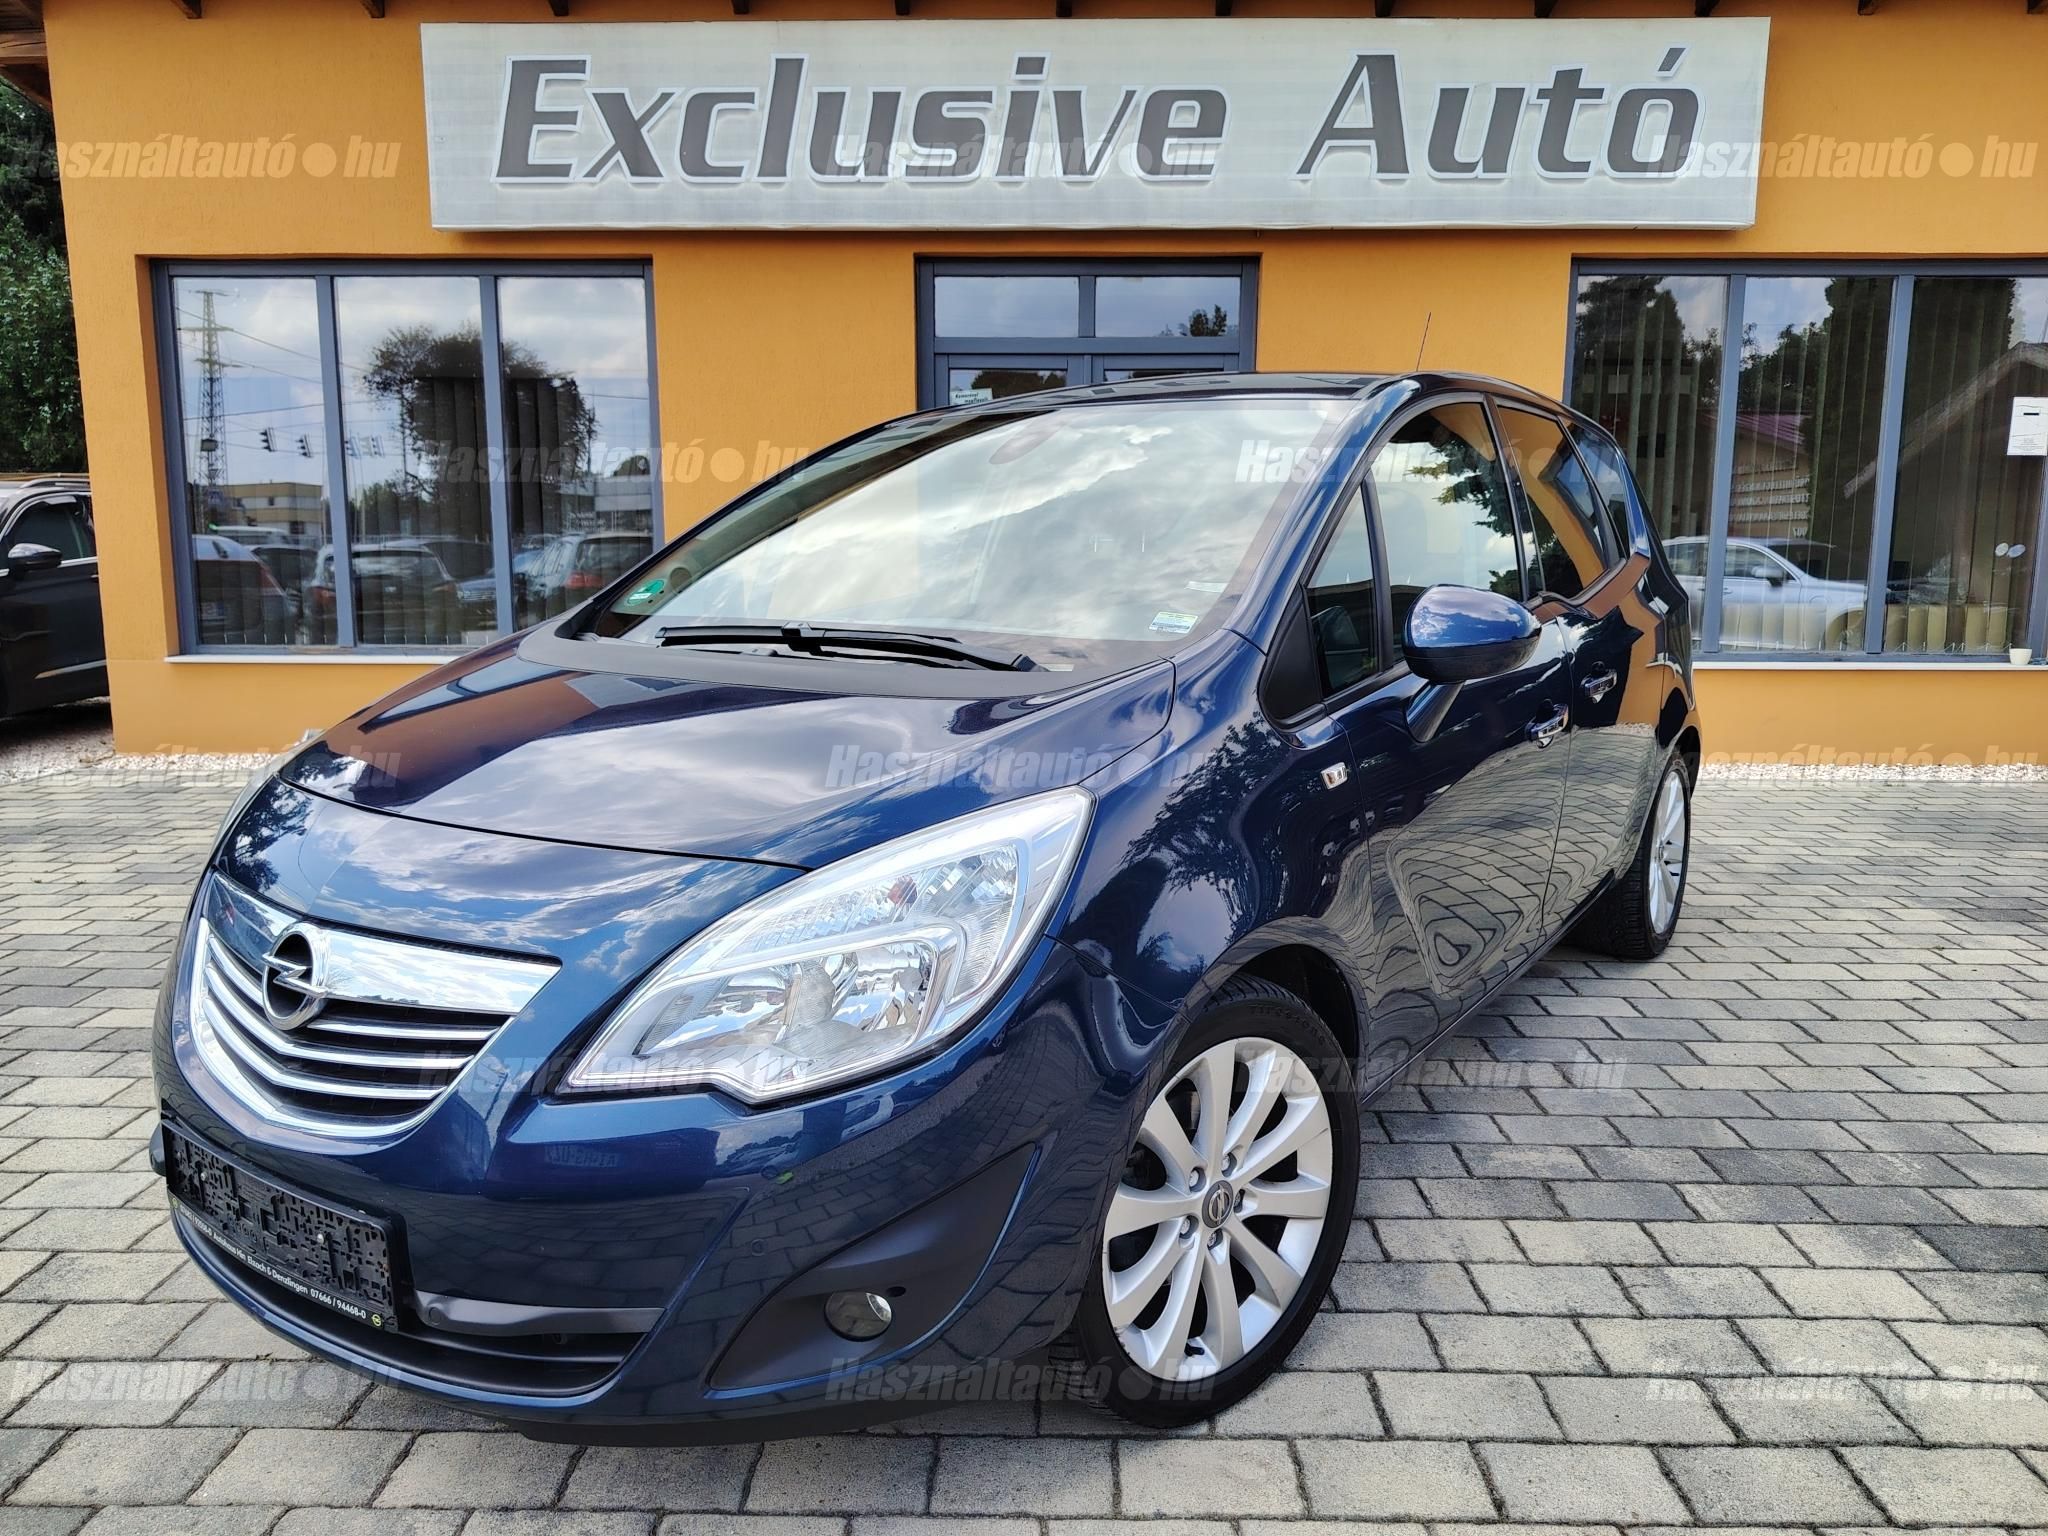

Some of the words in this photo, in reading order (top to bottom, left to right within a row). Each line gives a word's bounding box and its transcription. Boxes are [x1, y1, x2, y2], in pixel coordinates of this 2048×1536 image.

[491, 51, 1230, 185] Exclusive
[1291, 43, 1707, 181] Autó
[213, 1232, 237, 1255] Autohaus
[247, 1255, 267, 1273] Elzach
[272, 1269, 309, 1294] Denzlingen
[310, 1288, 332, 1306] 07666
[336, 1299, 367, 1319] 94468-0
